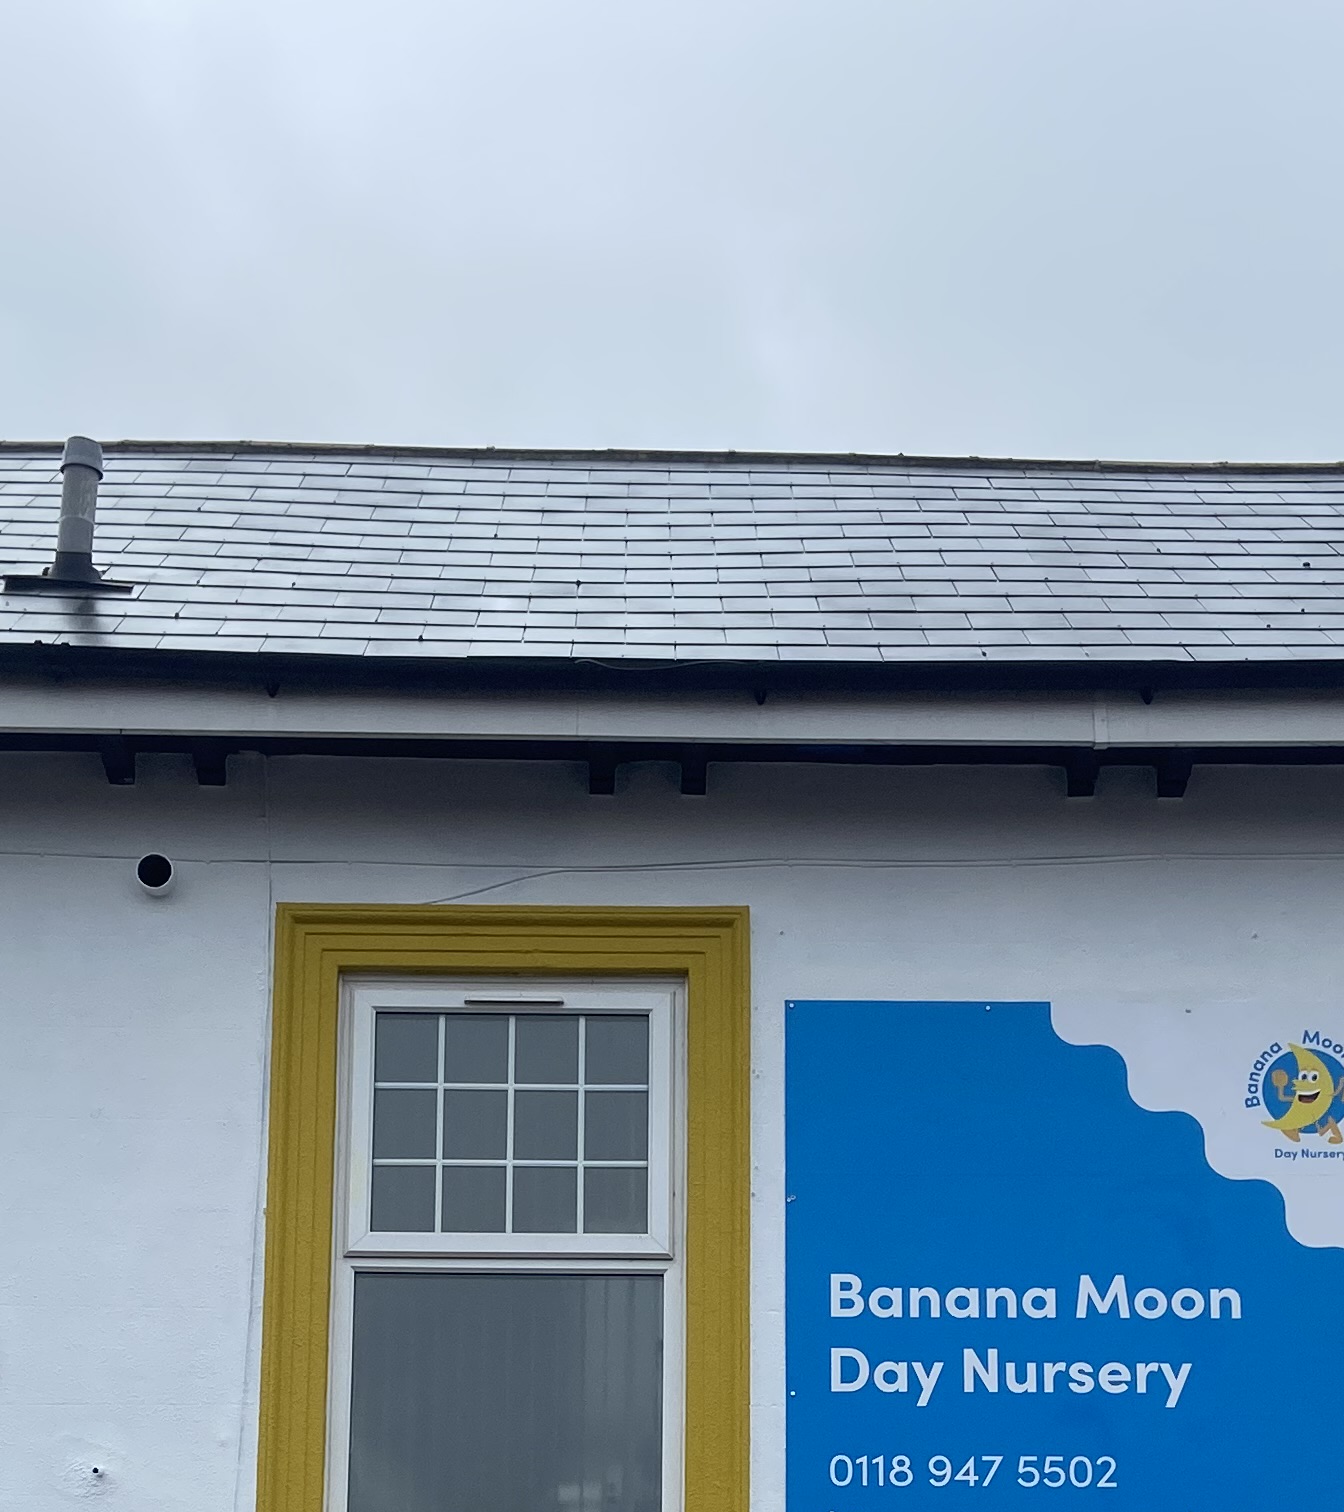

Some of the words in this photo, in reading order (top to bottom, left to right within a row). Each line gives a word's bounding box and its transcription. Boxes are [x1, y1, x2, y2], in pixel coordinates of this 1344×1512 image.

[1245, 1042, 1282, 1108] Banana
[1274, 1149, 1298, 1161] Day
[829, 1273, 1057, 1319] Banana
[1075, 1274, 1242, 1319] Moon
[829, 1347, 944, 1406] Day
[963, 1347, 1192, 1408] Nursery
[829, 1454, 914, 1487] 0118
[928, 1455, 1003, 1487] 947
[1016, 1455, 1118, 1488] 5502
